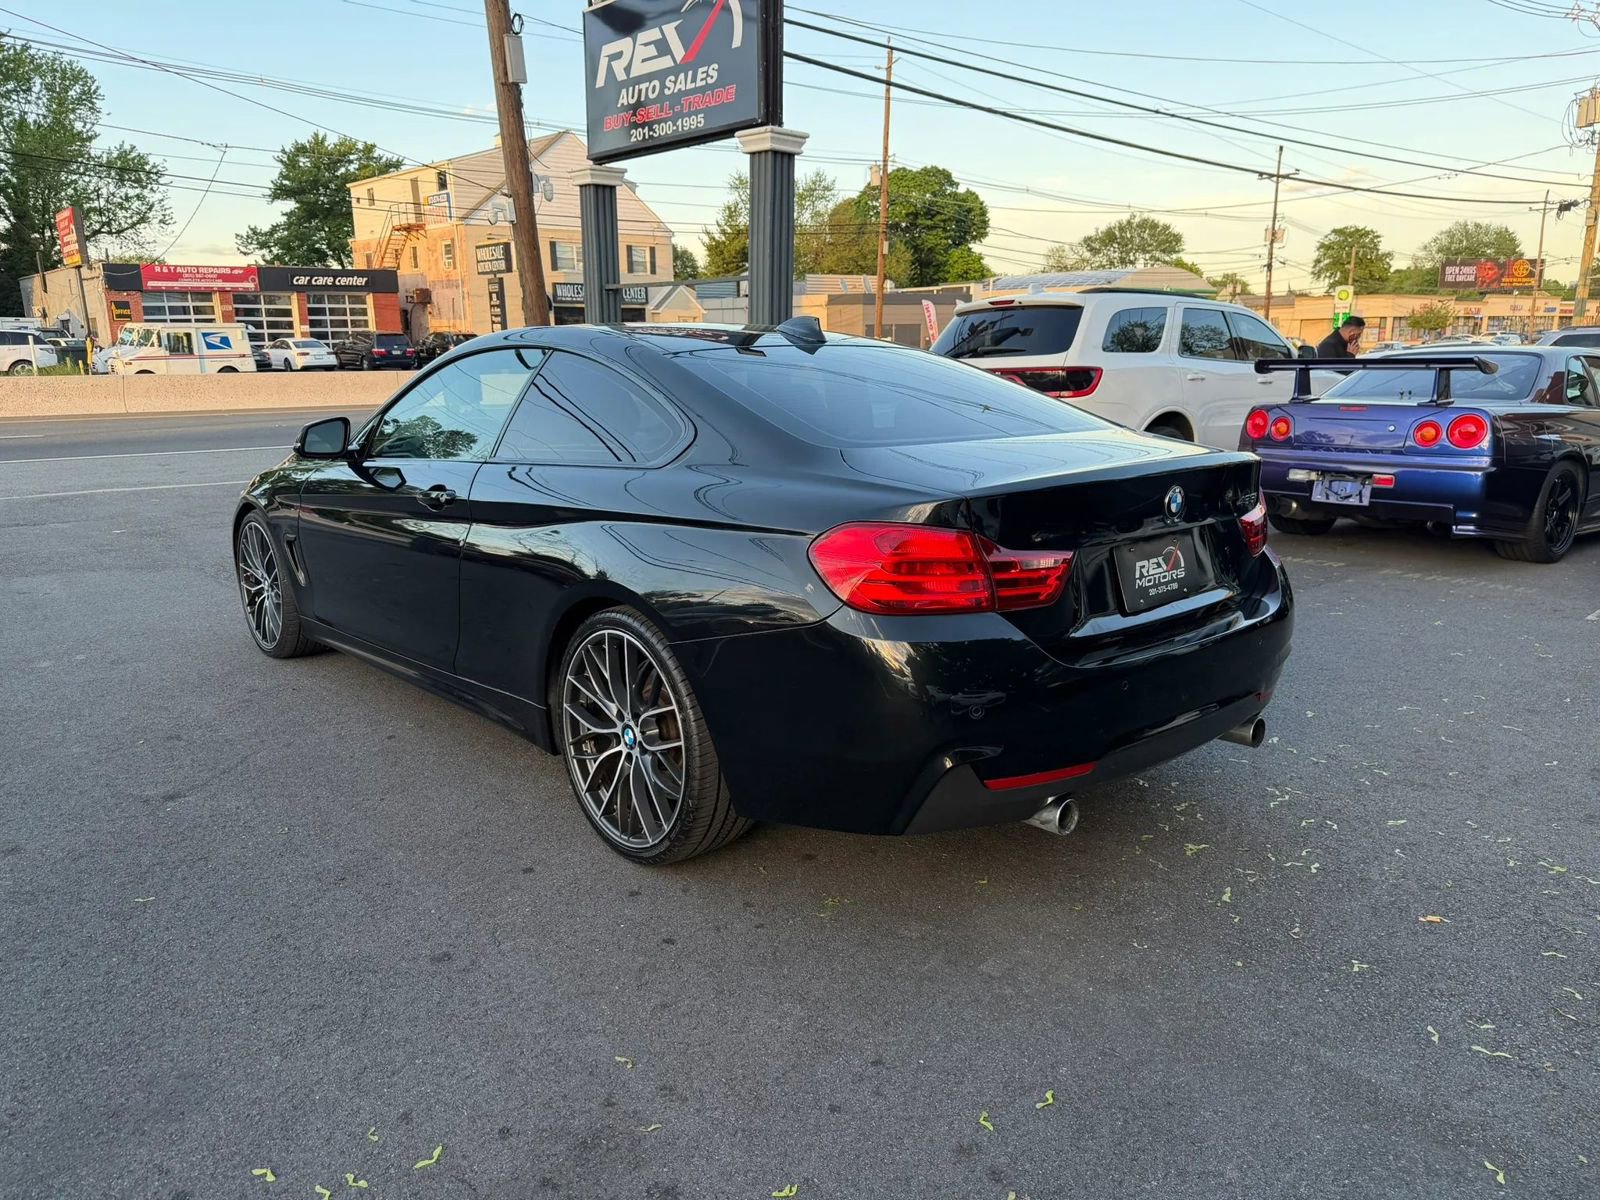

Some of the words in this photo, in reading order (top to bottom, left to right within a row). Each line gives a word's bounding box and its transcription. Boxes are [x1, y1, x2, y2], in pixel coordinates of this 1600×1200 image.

[596, 0, 724, 88] REV
[617, 79, 659, 107] AUTO
[664, 63, 719, 96] SALES
[630, 113, 705, 143] 201-300-1995
[176, 266, 198, 274] AUTO
[199, 267, 231, 275] REPAIRS
[1445, 266, 1460, 275] OPEN
[292, 275, 310, 285] car
[311, 276, 334, 285] care
[335, 275, 369, 286] center
[556, 284, 584, 297] WHOLES
[623, 287, 646, 299] CENTER
[1136, 568, 1185, 589] MOTORS
